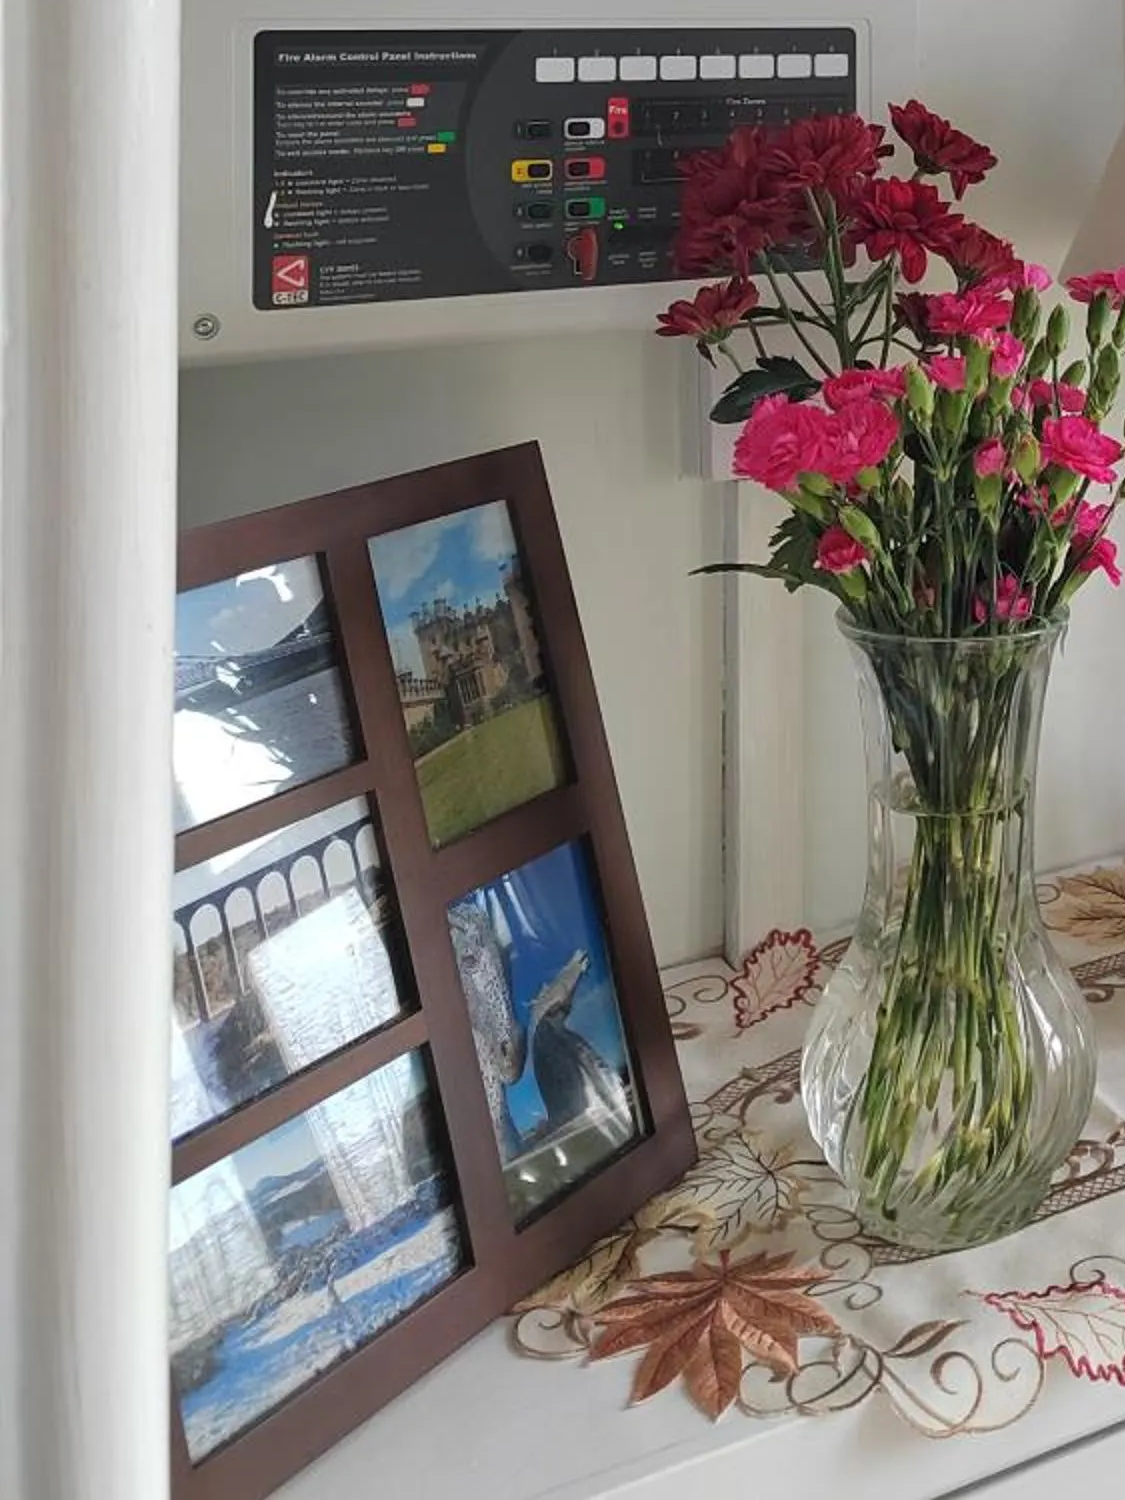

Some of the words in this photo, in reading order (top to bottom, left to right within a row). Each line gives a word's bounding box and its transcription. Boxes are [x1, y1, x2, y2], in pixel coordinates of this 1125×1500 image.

[278, 52, 300, 63] Fire
[303, 52, 337, 62] Alarm
[339, 51, 379, 62] Control
[381, 51, 412, 61] Panel
